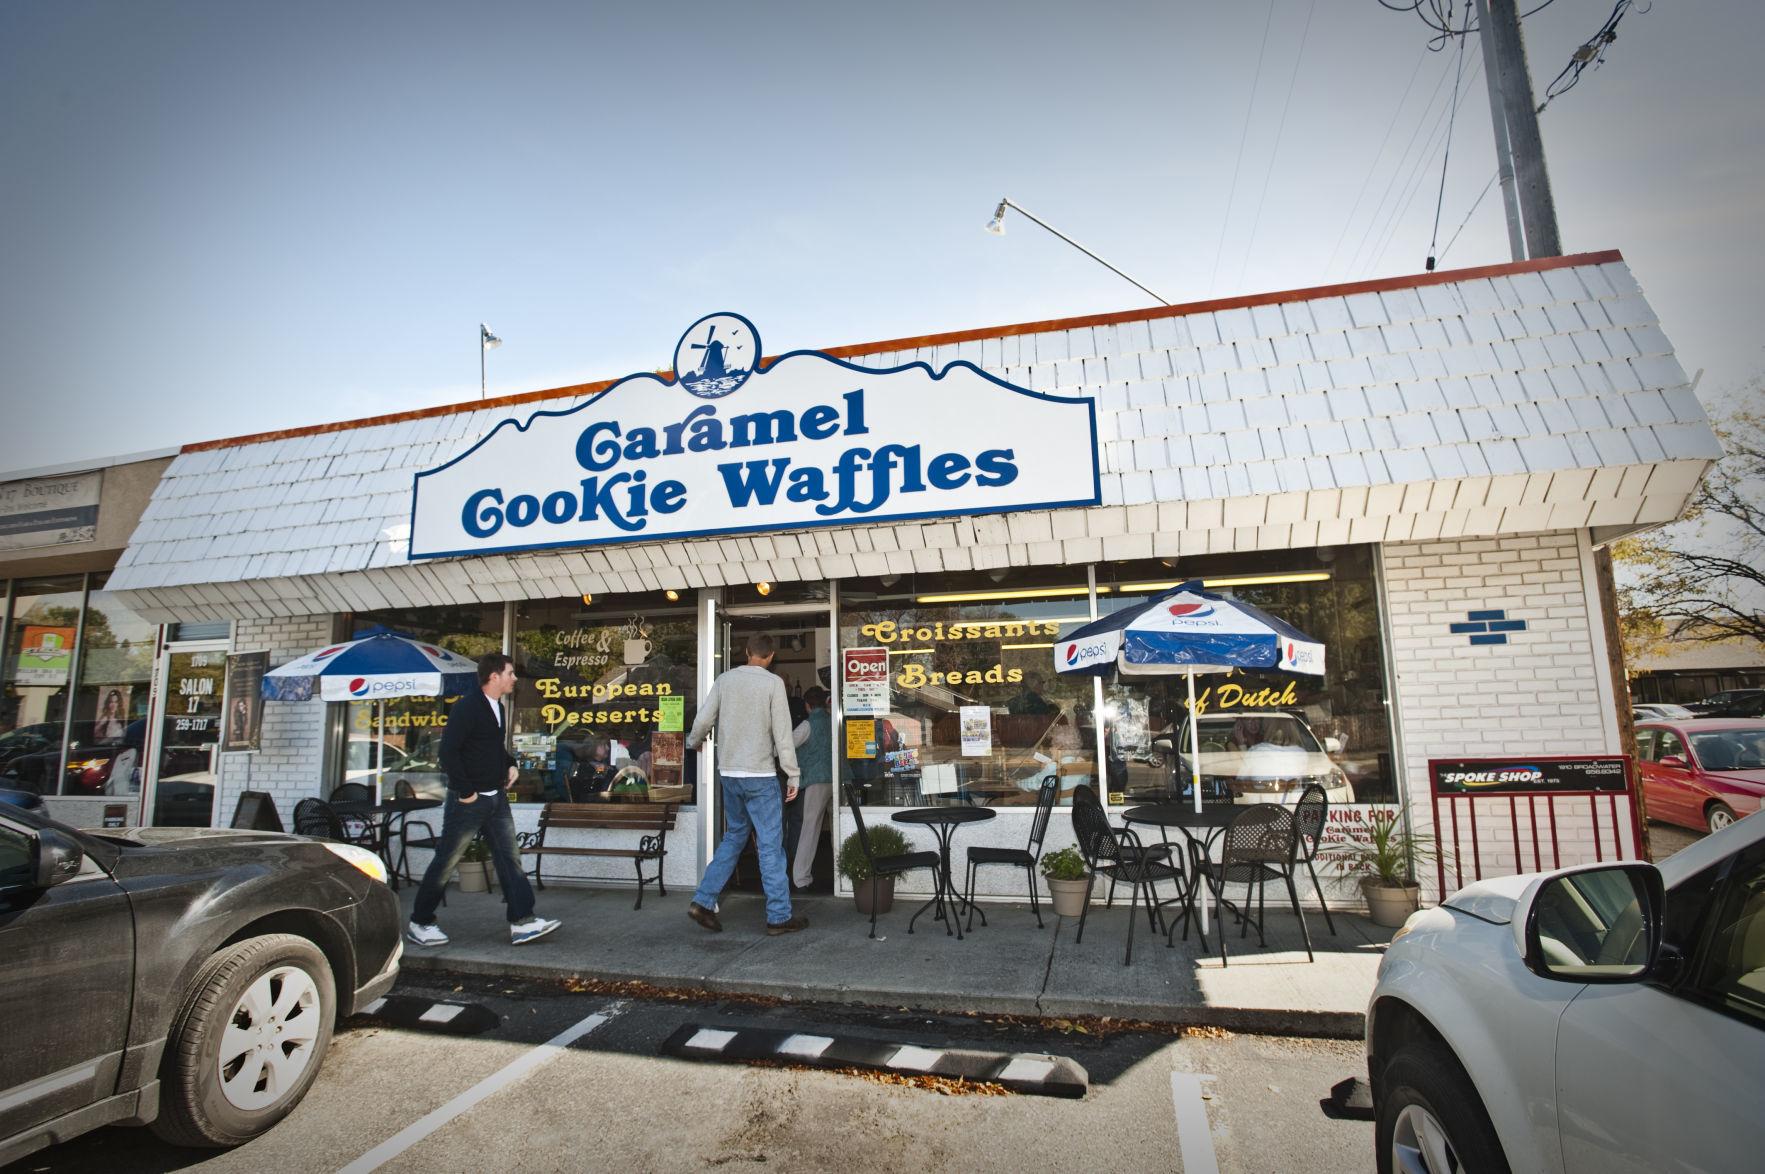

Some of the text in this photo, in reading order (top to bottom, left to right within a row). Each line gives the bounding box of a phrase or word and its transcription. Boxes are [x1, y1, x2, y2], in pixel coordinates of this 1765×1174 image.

[575, 388, 870, 472] Caramel
[717, 443, 1019, 516] Waffles
[1172, 618, 1219, 627] pepsi
[861, 620, 1061, 643] Croissants
[555, 628, 611, 653] Coffee &
[553, 652, 610, 669] Espresso
[1079, 643, 1108, 661] pepsi
[847, 659, 886, 676] Open
[897, 664, 1024, 689] Breads
[179, 678, 214, 695] SALON
[372, 679, 417, 694] pepsi
[535, 677, 673, 701] European
[1217, 681, 1298, 709] Dutch
[187, 696, 200, 713] 17
[354, 710, 449, 730] Sandwic
[540, 703, 666, 725] Desserts
[175, 719, 208, 731] 259-1717
[1445, 772, 1495, 783] SPOKE
[1498, 771, 1542, 782] SHOP
[1303, 809, 1395, 824] PAKING FOR
[1314, 853, 1357, 861] DDITIONAL
